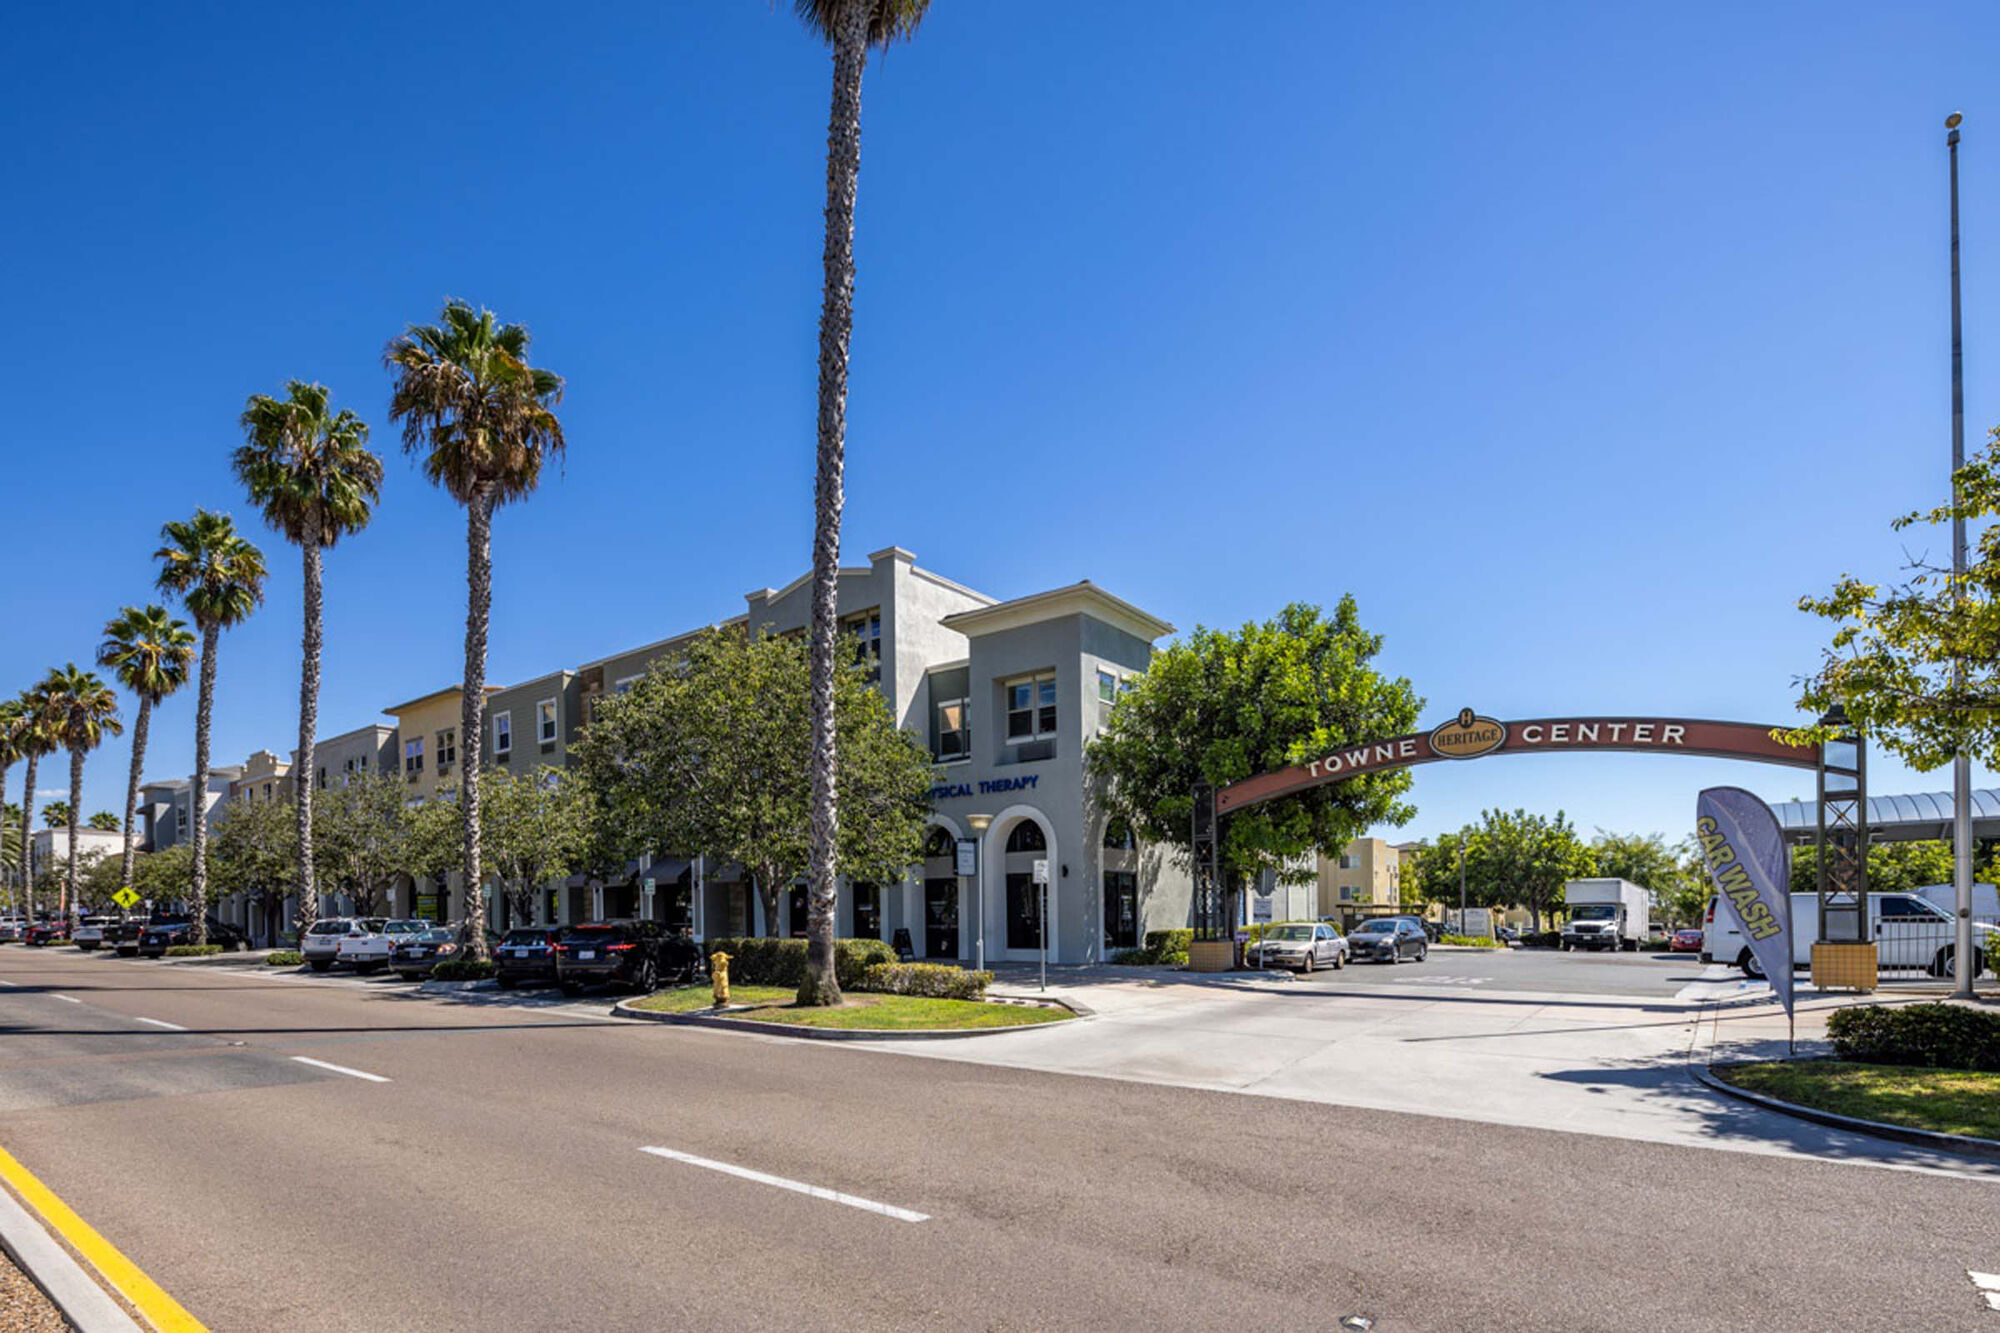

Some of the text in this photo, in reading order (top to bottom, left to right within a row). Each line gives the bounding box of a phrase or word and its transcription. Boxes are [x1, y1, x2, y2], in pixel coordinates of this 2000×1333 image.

[1461, 711, 1473, 726] H
[1306, 723, 1686, 777] TOWNE CENTER
[1437, 728, 1499, 747] HERITAGE
[922, 774, 1039, 799] YSICAL THERAPY
[1697, 815, 1782, 940] CAR WASH
